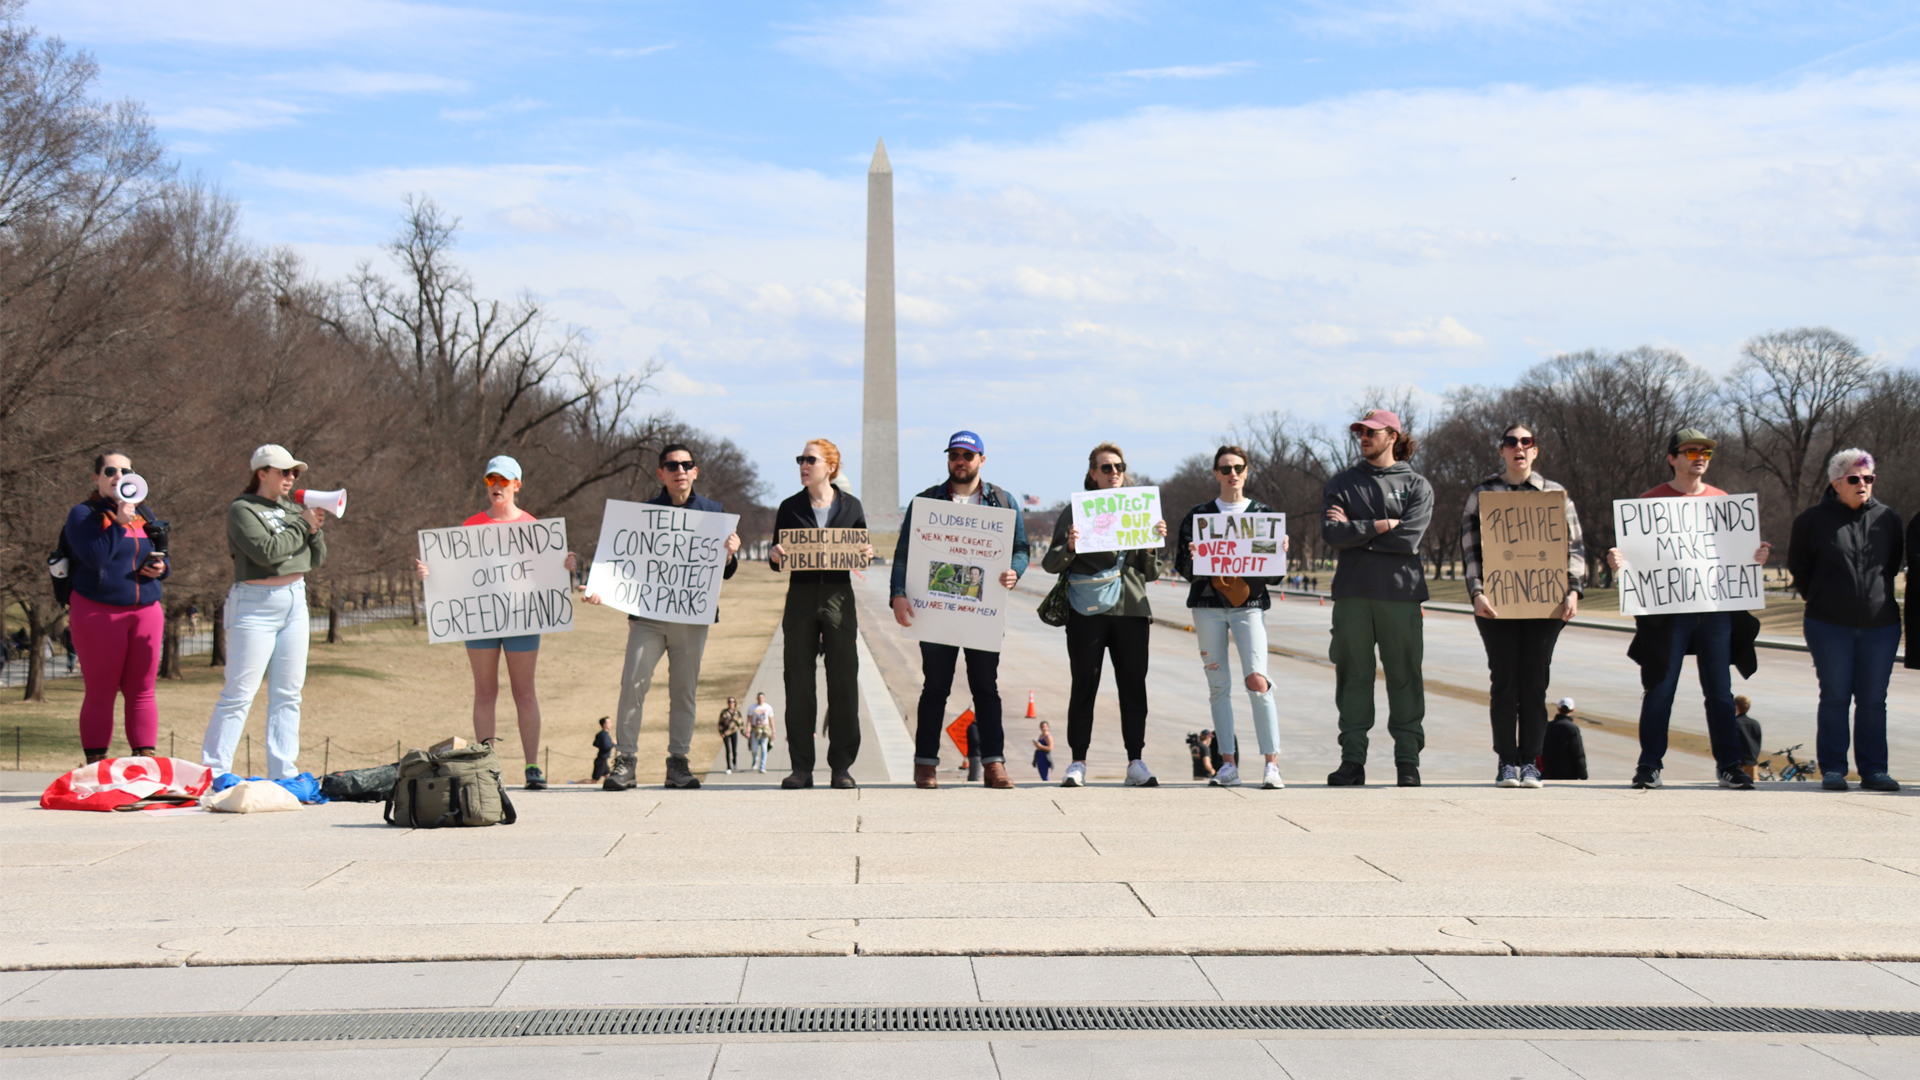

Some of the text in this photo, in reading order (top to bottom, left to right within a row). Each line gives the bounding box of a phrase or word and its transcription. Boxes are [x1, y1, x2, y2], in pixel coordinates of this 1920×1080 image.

[1082, 492, 1155, 518] PROTECT
[1620, 498, 1756, 536] PUBLIC LANDS
[642, 509, 695, 532] TELL
[1121, 512, 1151, 529] OUR
[1197, 515, 1281, 540] PLANET
[1486, 506, 1562, 544] REHIRE
[421, 521, 564, 562] PUBLIC LANDS
[613, 529, 720, 562] CONGRESS
[780, 530, 868, 544] PUBLIC LANDS
[944, 533, 960, 543] MEN
[961, 535, 993, 548] CREATE
[1116, 525, 1161, 547] PARKS
[1656, 533, 1721, 561] MAKE
[780, 551, 867, 569] PUBLIC HANDS
[949, 546, 968, 556] HARD
[1197, 541, 1238, 558] OVER
[472, 559, 535, 587] OUT OF
[606, 559, 718, 591] TO PROTECT
[1210, 556, 1268, 574] PROFIT
[614, 581, 707, 616] OUR PARKS
[1486, 568, 1566, 607] RANGERS
[1622, 563, 1761, 613] AMERICA GREAT
[430, 587, 573, 637] GREEDY HANDS
[913, 598, 998, 618] YOU ARE THE WEAK MEN
